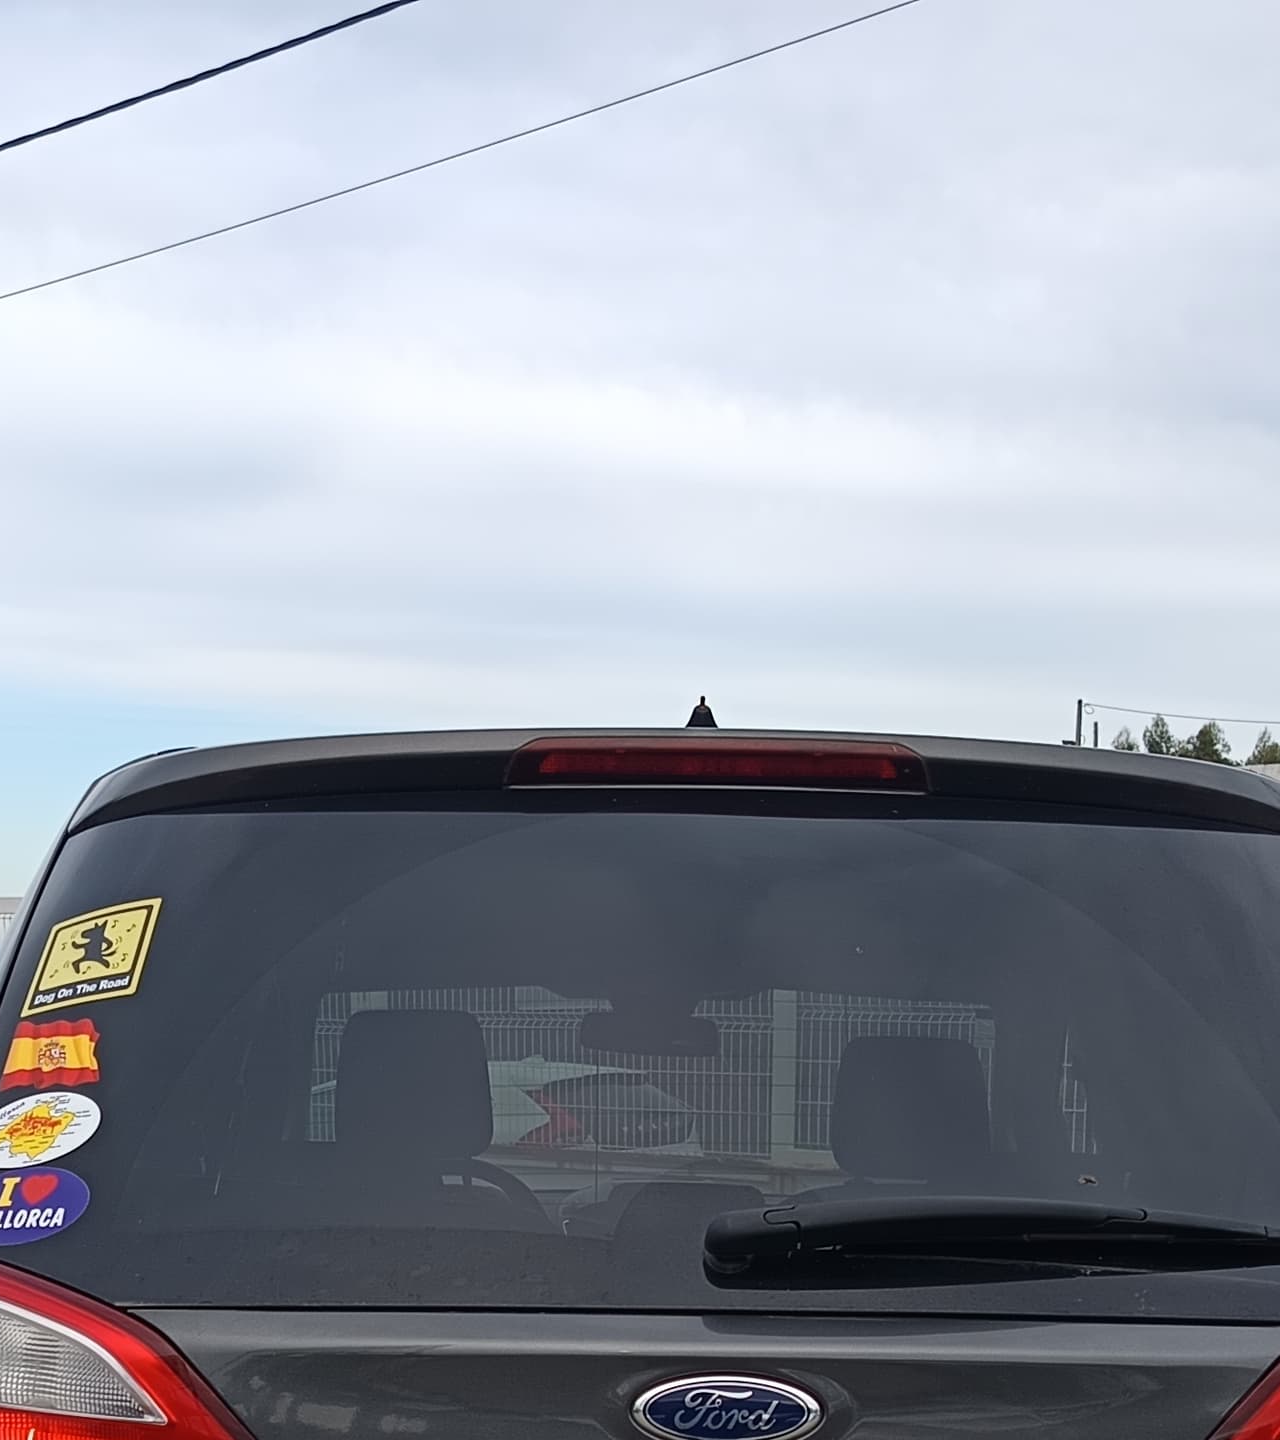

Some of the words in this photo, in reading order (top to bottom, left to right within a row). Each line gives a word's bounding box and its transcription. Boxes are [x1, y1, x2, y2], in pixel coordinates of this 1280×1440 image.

[33, 992, 56, 1005] Dog
[57, 988, 73, 999] On
[76, 983, 97, 995] The
[98, 975, 130, 990] Road
[673, 1388, 778, 1432] Ford
